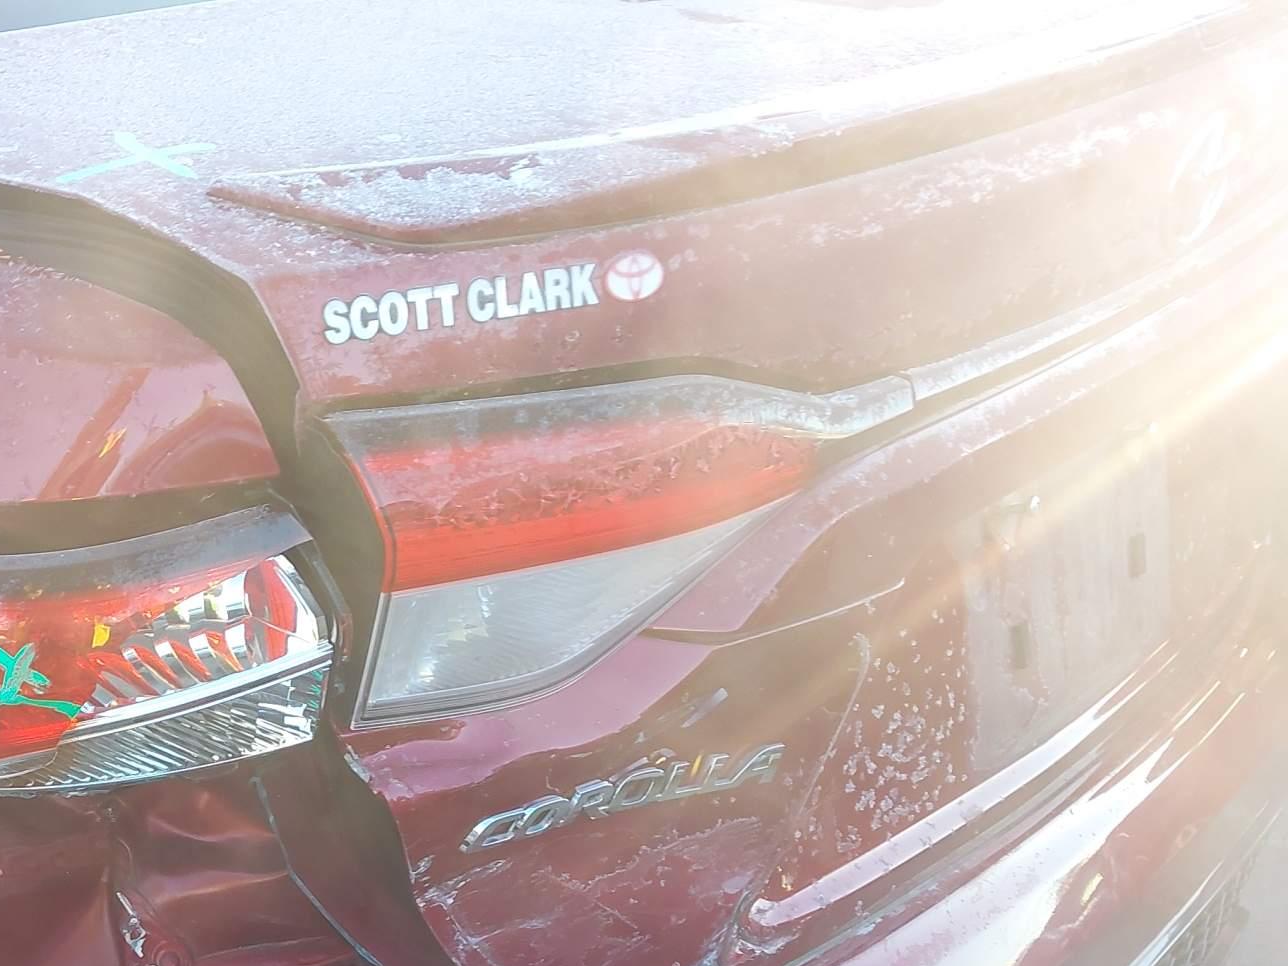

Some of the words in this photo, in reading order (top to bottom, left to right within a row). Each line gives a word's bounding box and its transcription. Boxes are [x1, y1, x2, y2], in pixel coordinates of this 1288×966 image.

[323, 282, 459, 345] SCOTT
[466, 262, 600, 324] CLARK
[459, 743, 785, 853] COROLLA
